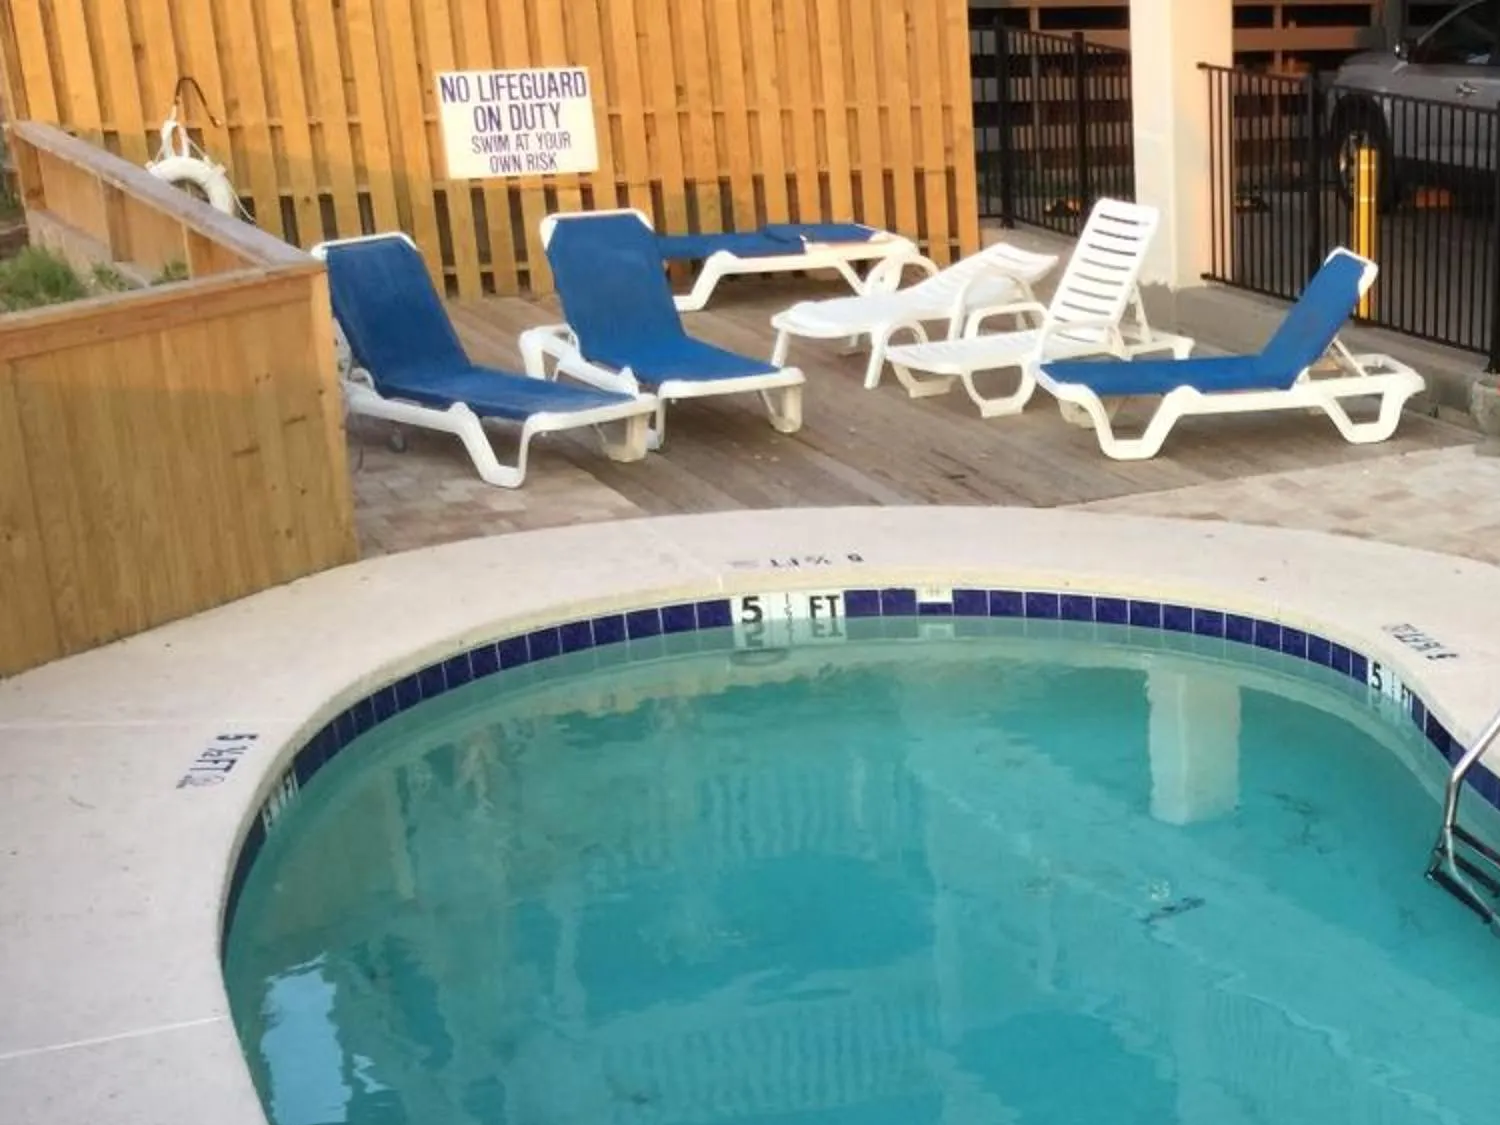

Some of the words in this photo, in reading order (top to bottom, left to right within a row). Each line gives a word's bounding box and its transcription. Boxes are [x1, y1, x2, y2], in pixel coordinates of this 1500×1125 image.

[440, 75, 470, 103] NO
[477, 71, 587, 102] LIFEGUARD
[473, 105, 502, 132] ON
[509, 102, 560, 131] DUTY
[472, 134, 510, 154] SWIM
[515, 133, 531, 150] AT
[535, 131, 571, 151] YOUR
[489, 153, 522, 173] OWN
[526, 151, 557, 171] RISK
[741, 595, 763, 624] 5
[809, 594, 841, 619] FT
[1371, 661, 1383, 691] 5
